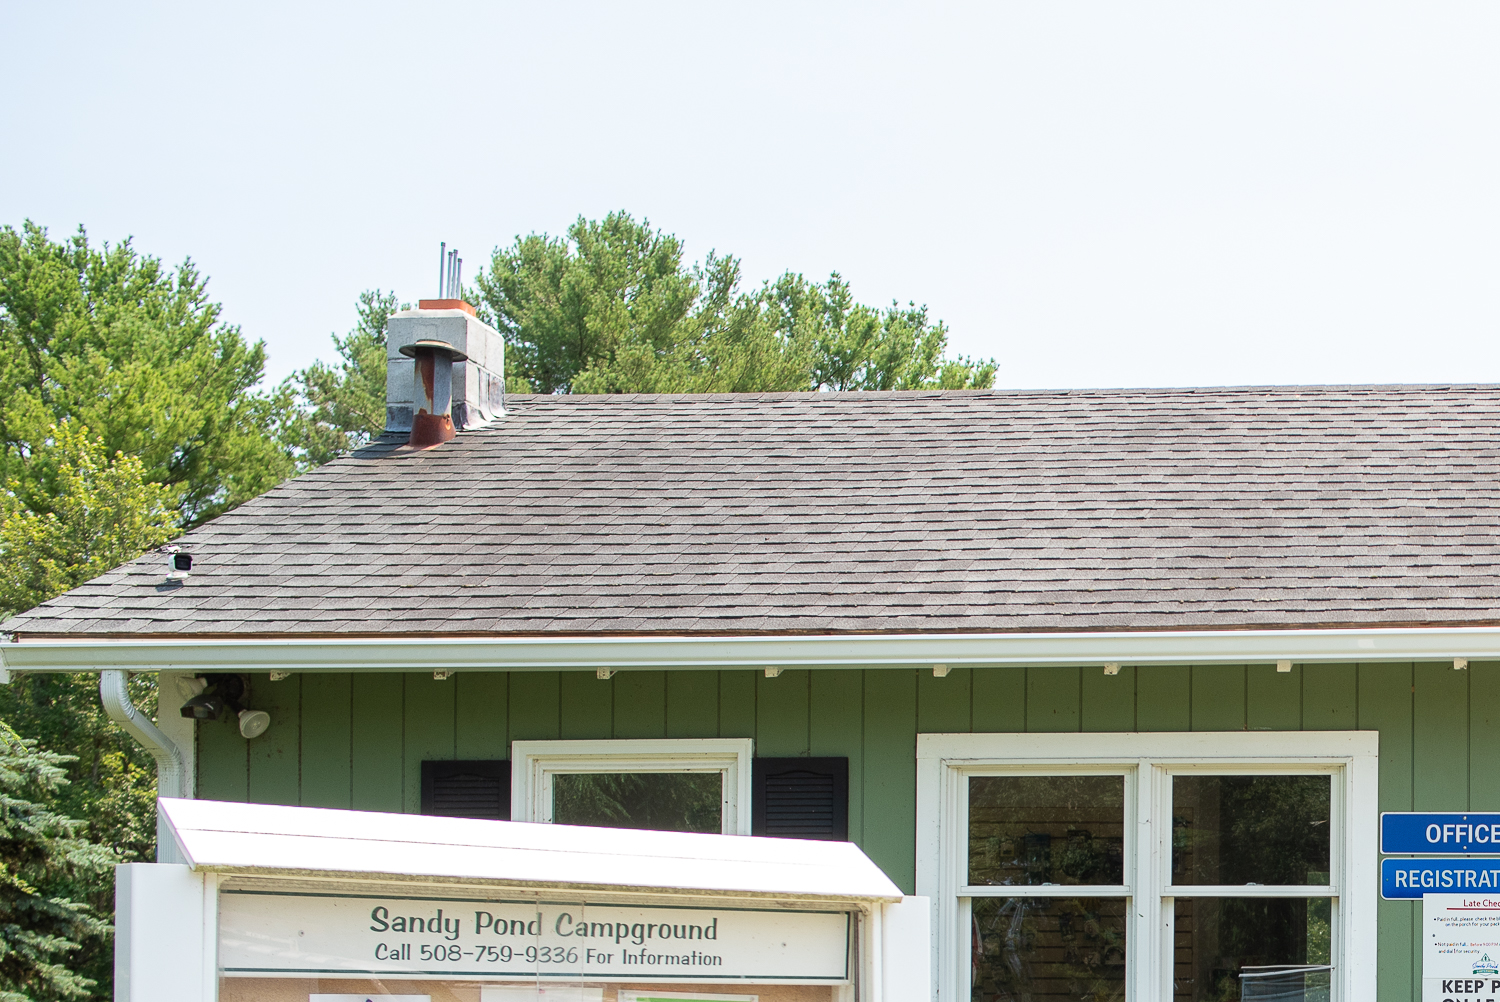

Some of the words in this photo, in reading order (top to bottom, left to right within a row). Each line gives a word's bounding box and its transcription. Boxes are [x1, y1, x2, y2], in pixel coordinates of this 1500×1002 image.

[1463, 899, 1481, 907] Late
[370, 906, 460, 941] Sandy
[475, 911, 544, 938] Pond
[555, 912, 718, 945] Campground
[374, 942, 411, 961] Call
[420, 944, 579, 965] 508-759-9336
[586, 948, 614, 966] For
[622, 948, 723, 967] Information
[1442, 980, 1484, 994] KEEP
